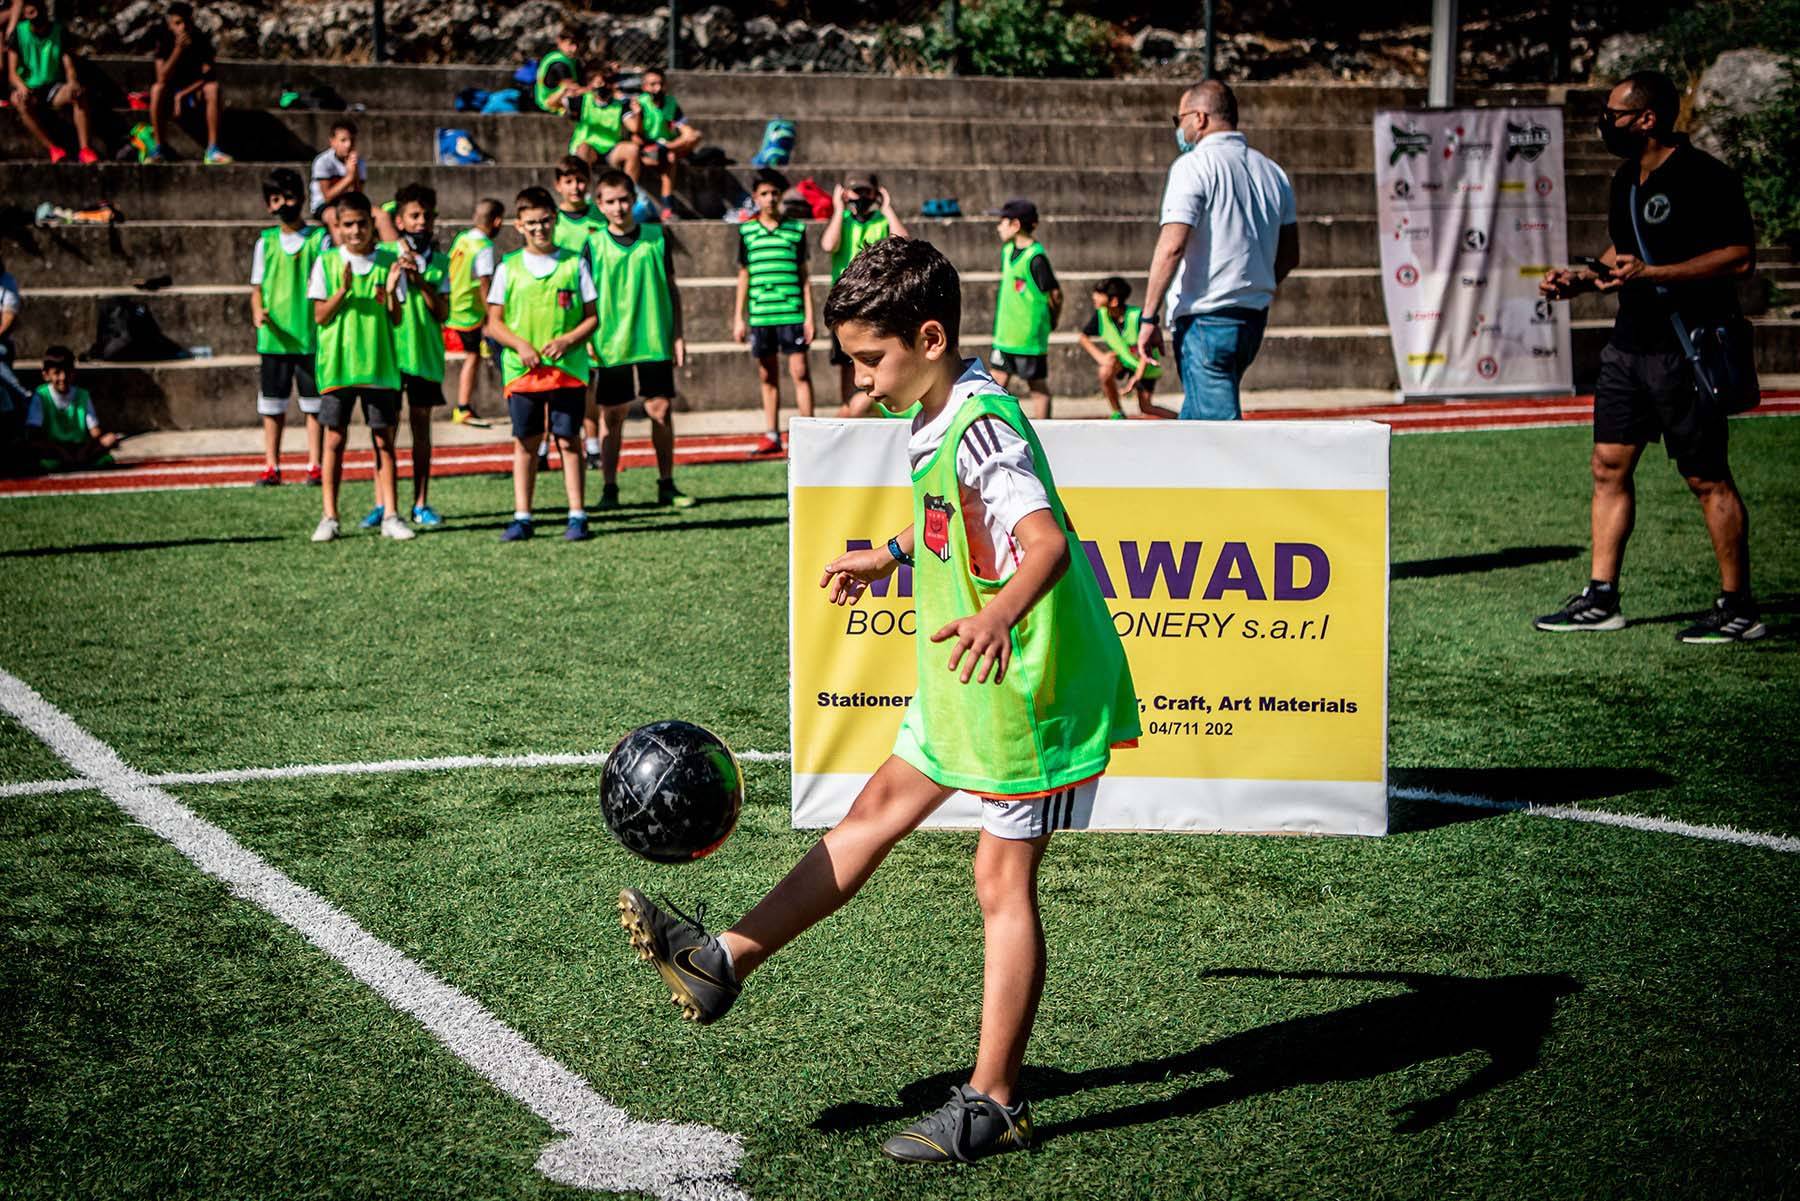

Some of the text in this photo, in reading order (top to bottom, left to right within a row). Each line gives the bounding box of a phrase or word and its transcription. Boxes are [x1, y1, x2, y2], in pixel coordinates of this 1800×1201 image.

[846, 610, 1329, 640] BOO ONERY s.a.r.l
[817, 692, 913, 708] Stationer
[1153, 695, 1212, 714] Craft,
[1218, 697, 1252, 711] Art
[1258, 697, 1358, 713] Materials
[1149, 722, 1233, 736] 04/711 202
